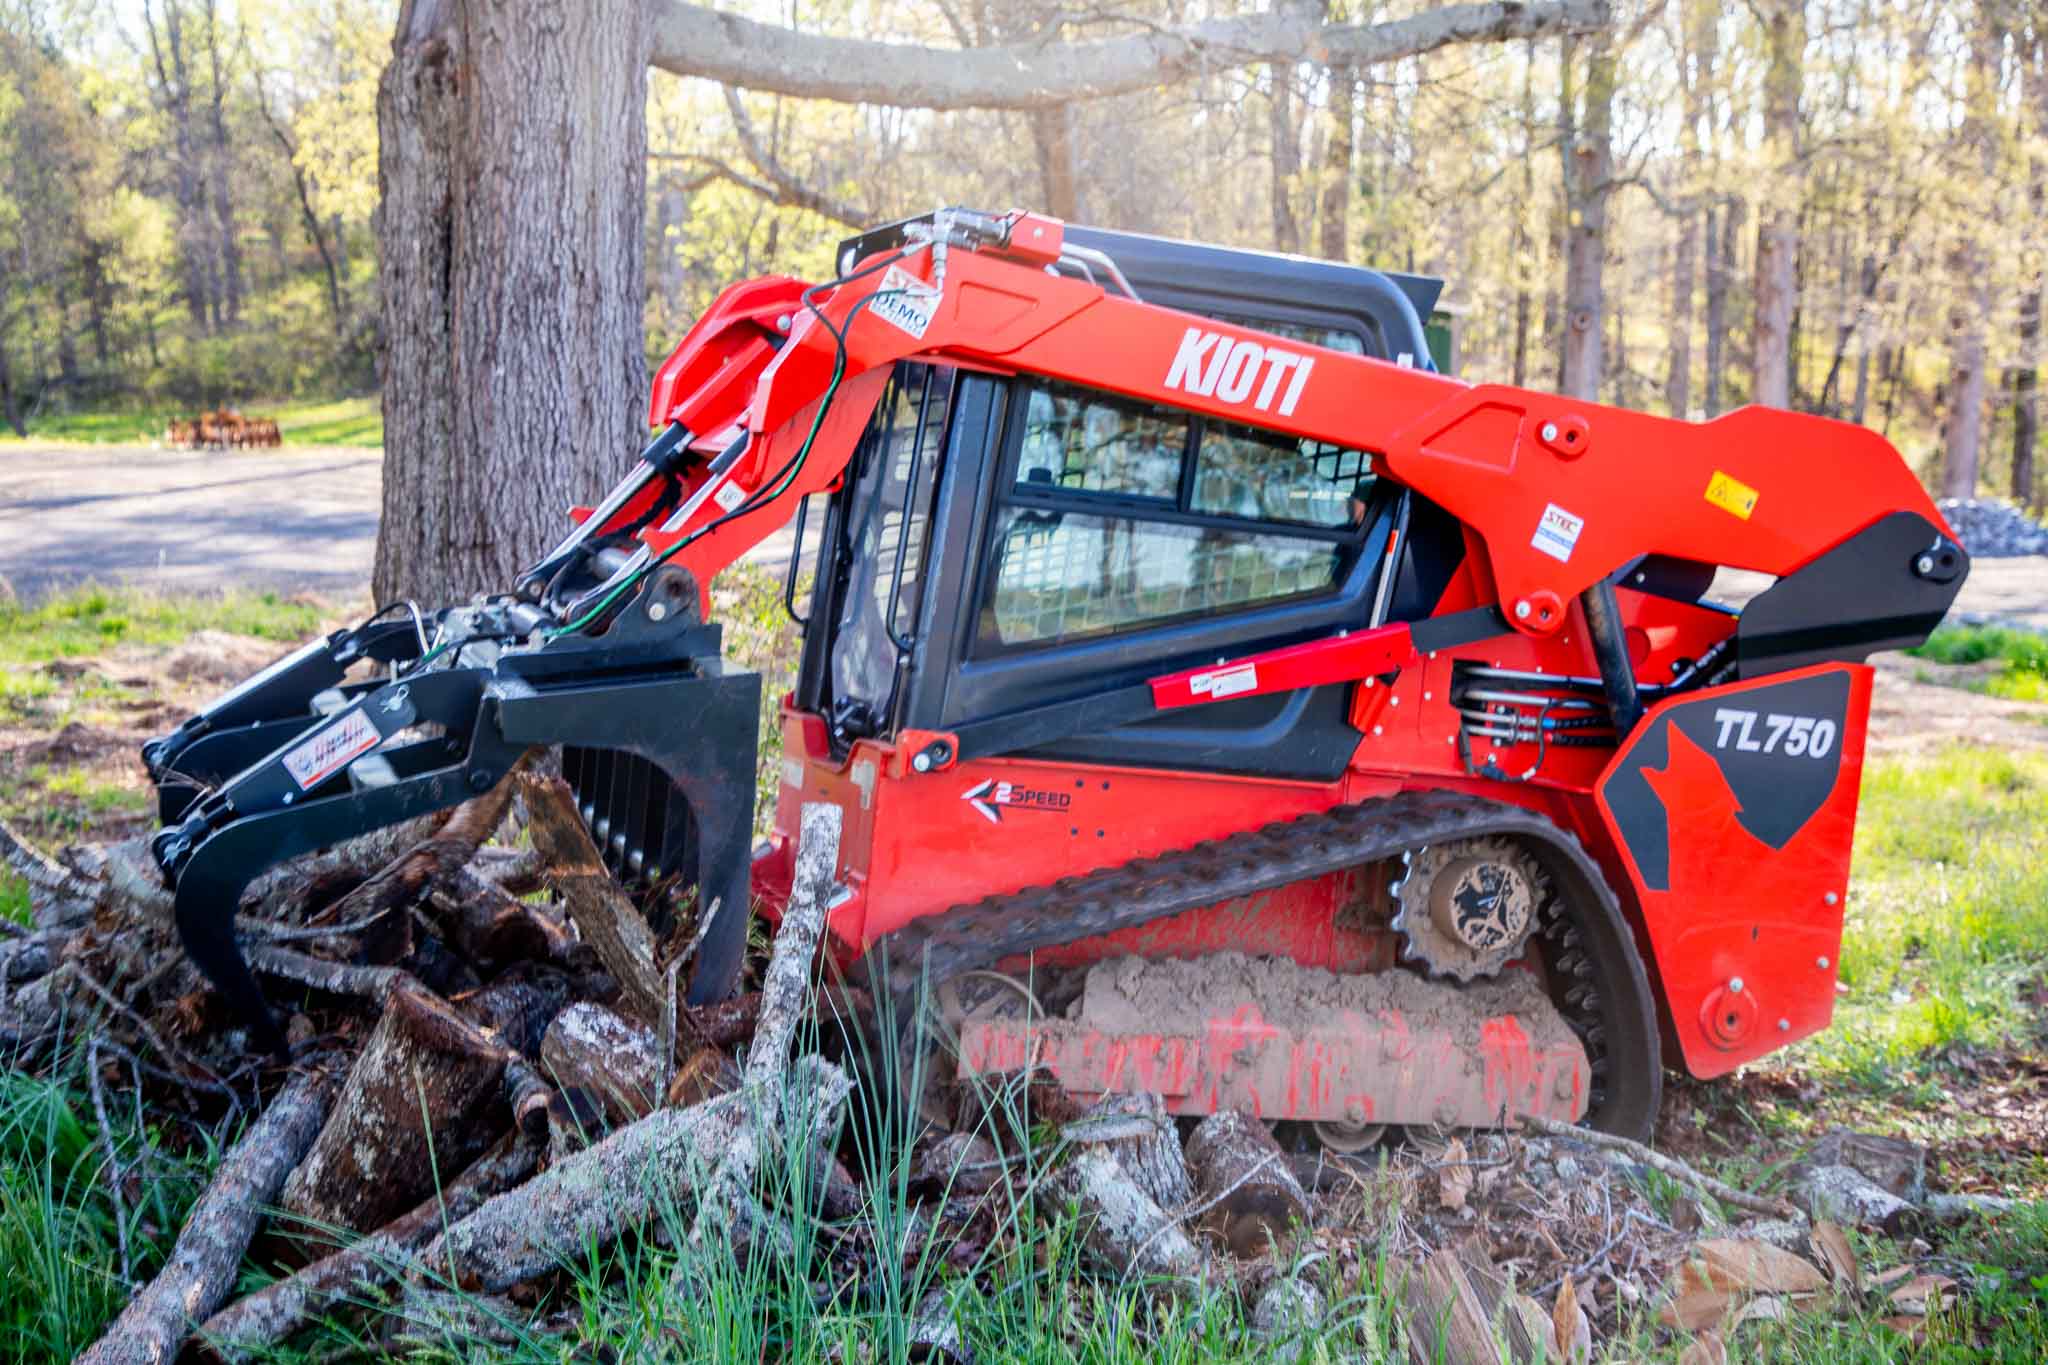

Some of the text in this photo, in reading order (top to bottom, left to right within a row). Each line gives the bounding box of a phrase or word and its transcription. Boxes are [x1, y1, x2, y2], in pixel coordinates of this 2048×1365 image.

[876, 291, 928, 328] DEMO
[1163, 327, 1315, 417] KIOTI
[1714, 708, 1837, 759] TL750
